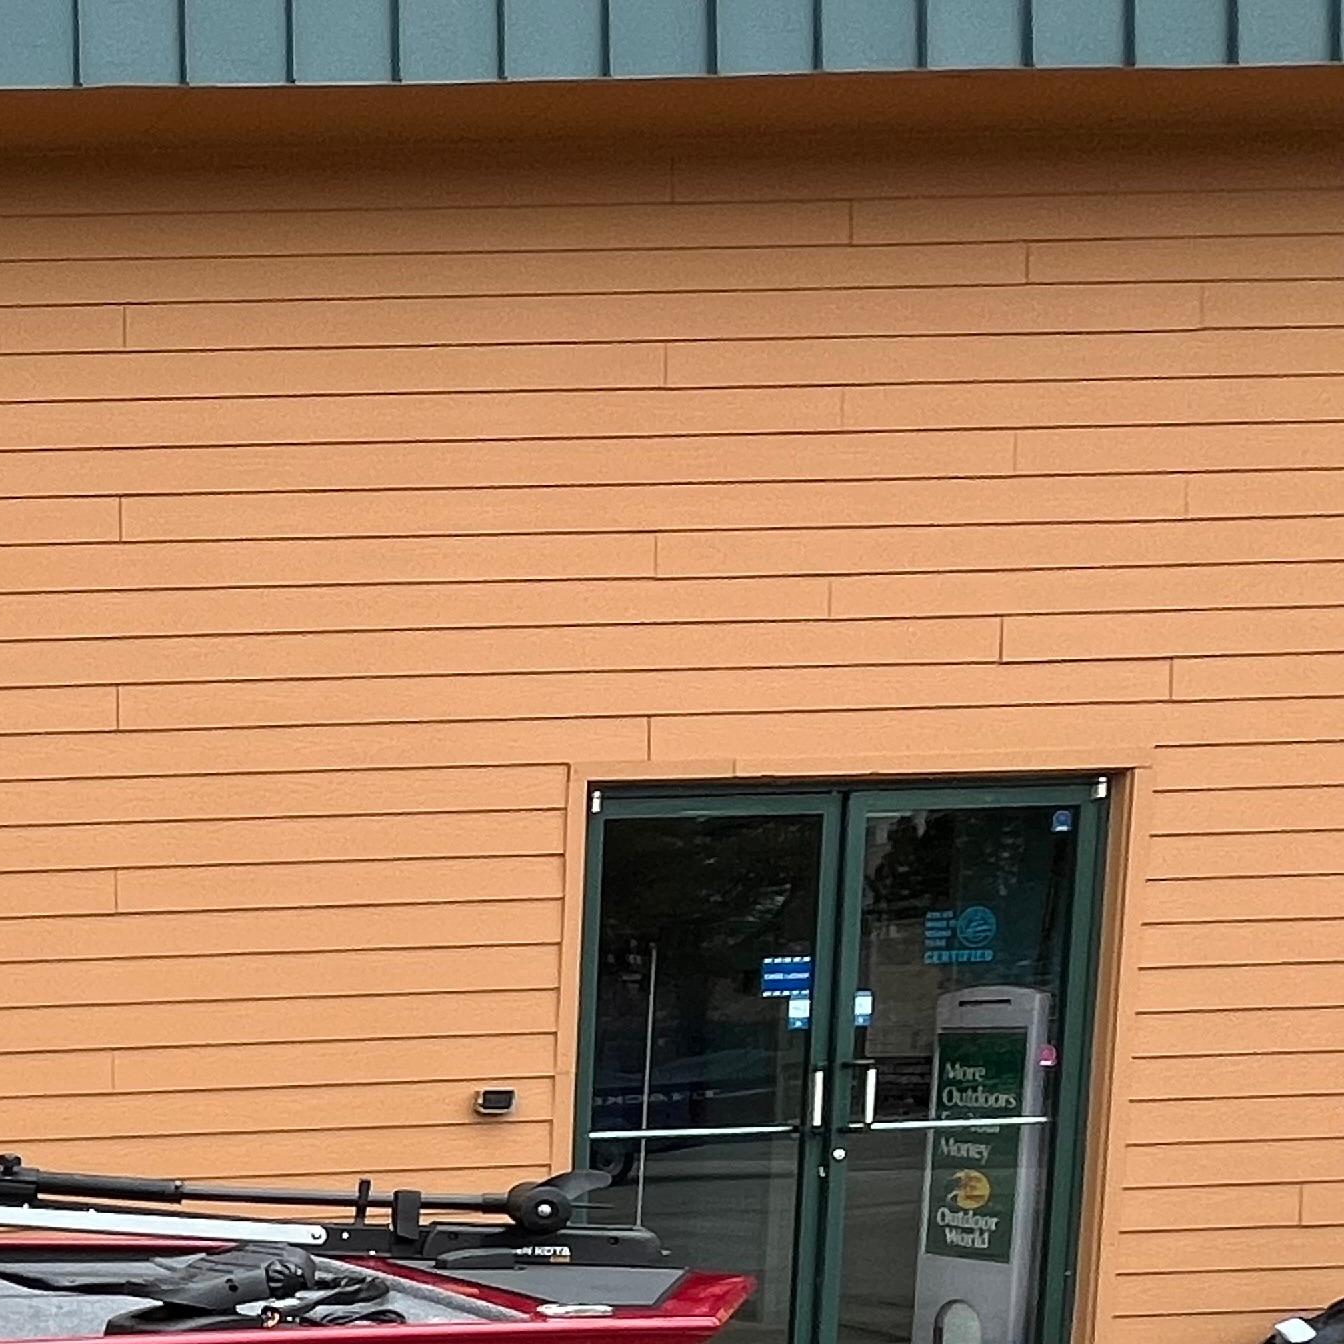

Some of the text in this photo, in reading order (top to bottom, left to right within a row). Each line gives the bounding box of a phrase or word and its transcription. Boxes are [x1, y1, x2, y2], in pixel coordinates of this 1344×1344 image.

[942, 1061, 986, 1081] More
[942, 1085, 1017, 1108] Outdoors
[939, 1136, 992, 1165] Money
[936, 1206, 1000, 1230] Outdoor
[945, 1227, 990, 1248] World
